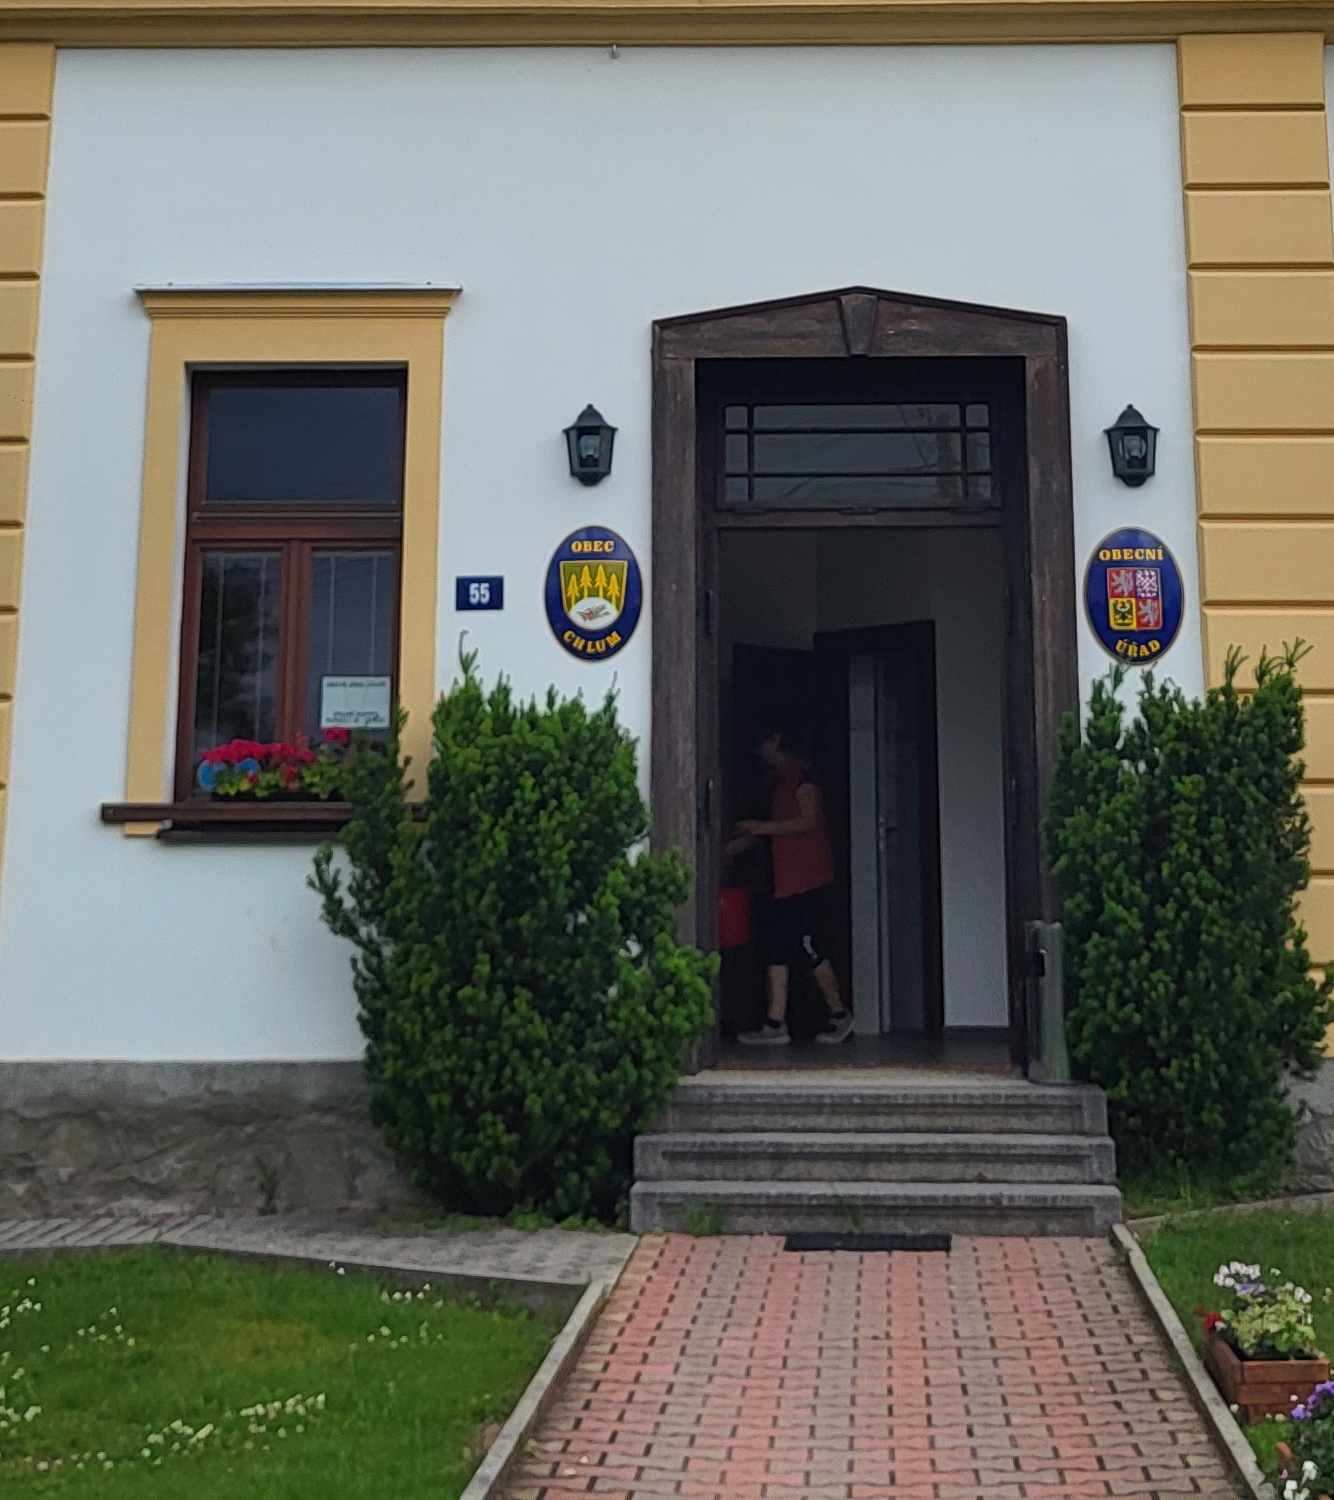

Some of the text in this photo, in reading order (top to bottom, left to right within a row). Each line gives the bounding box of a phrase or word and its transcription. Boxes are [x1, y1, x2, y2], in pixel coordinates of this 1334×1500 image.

[571, 540, 614, 553] OBEC
[1098, 545, 1164, 561] OBECNÍ
[468, 582, 491, 604] 55
[563, 630, 622, 654] CHLUM
